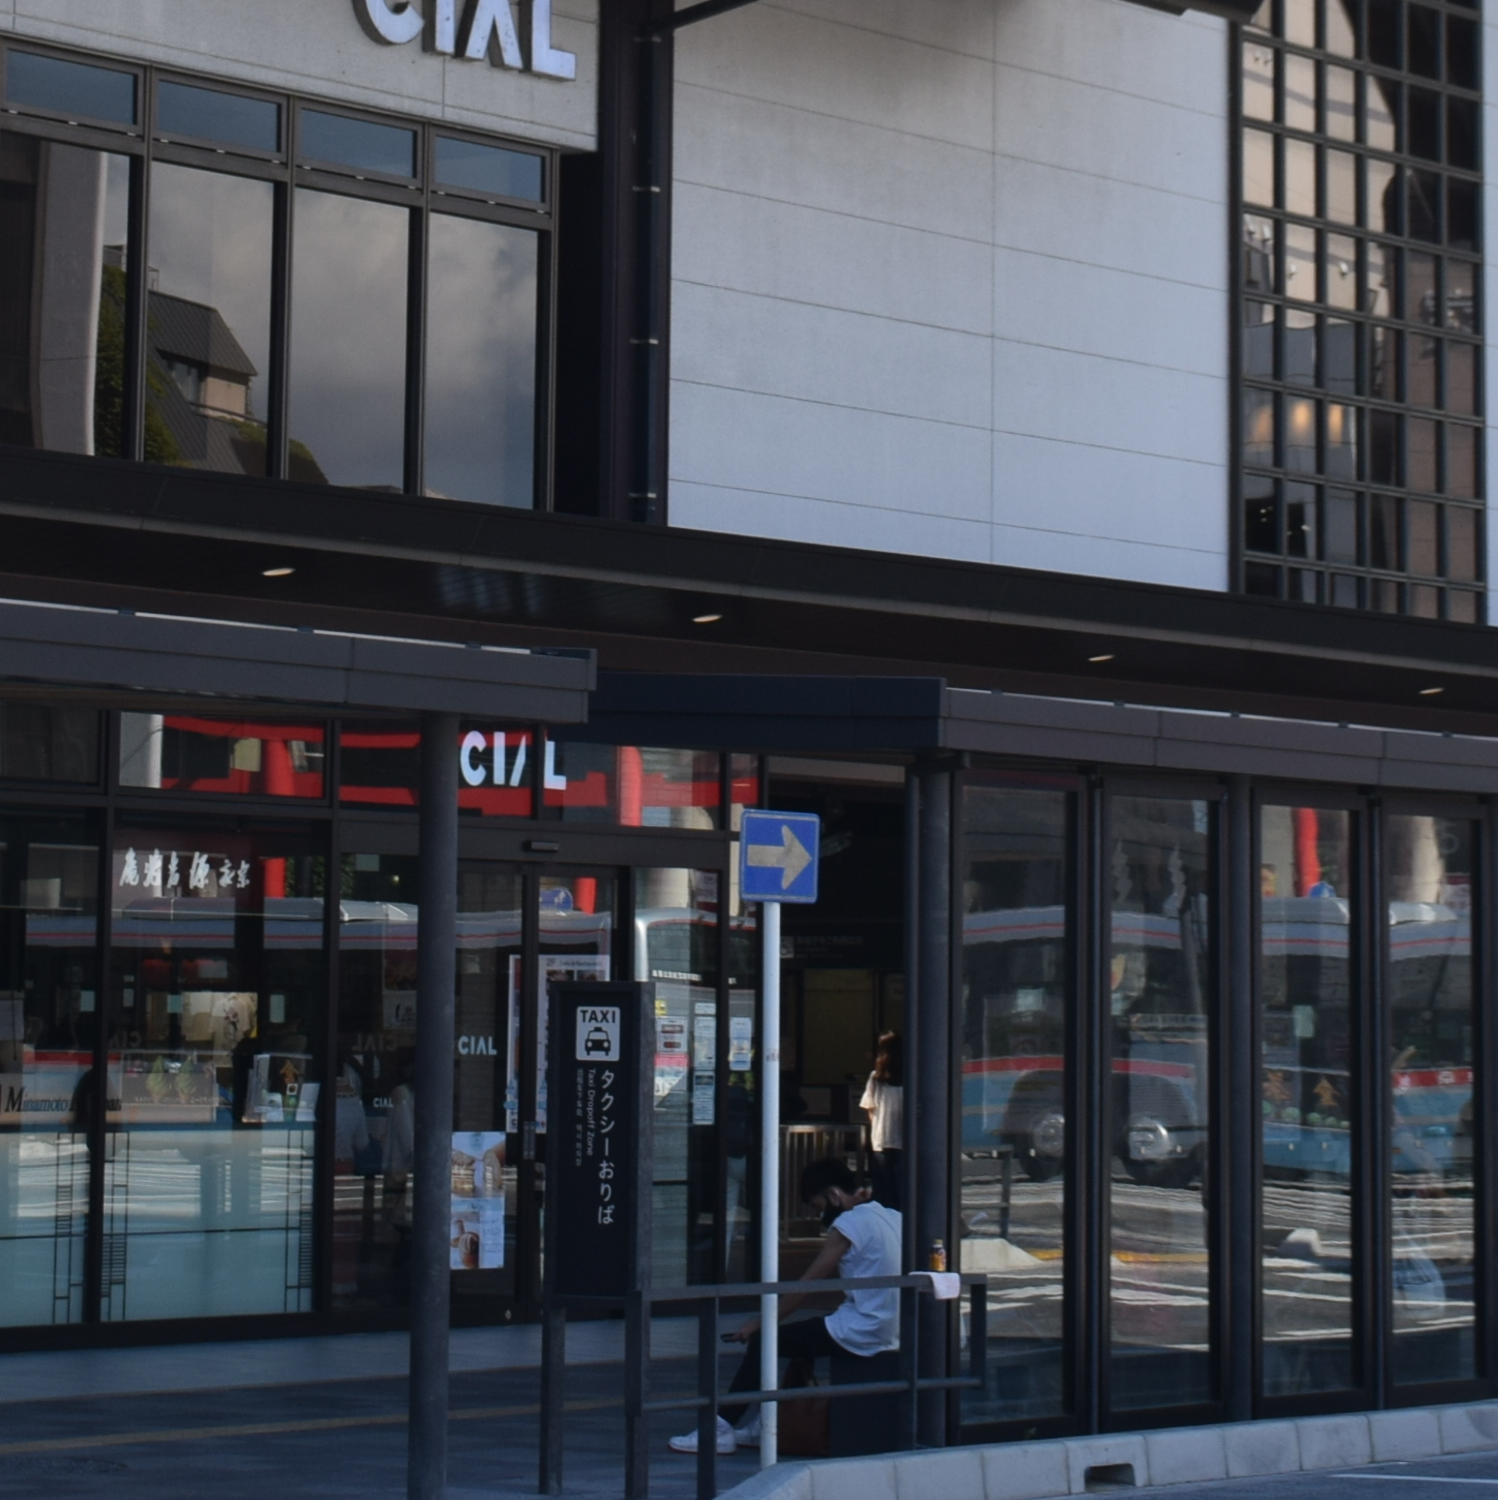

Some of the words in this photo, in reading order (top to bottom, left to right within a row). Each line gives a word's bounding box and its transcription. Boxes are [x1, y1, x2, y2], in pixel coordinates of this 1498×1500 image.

[580, 1009, 616, 1024] TAXI
[458, 1035, 498, 1056] CIAL
[587, 1068, 596, 1087] Taxi
[4, 1086, 68, 1112] Minamoto
[586, 1089, 596, 1129] Dropoff
[586, 1131, 595, 1156] Zone
[597, 1069, 615, 1224] タクシーおりば
